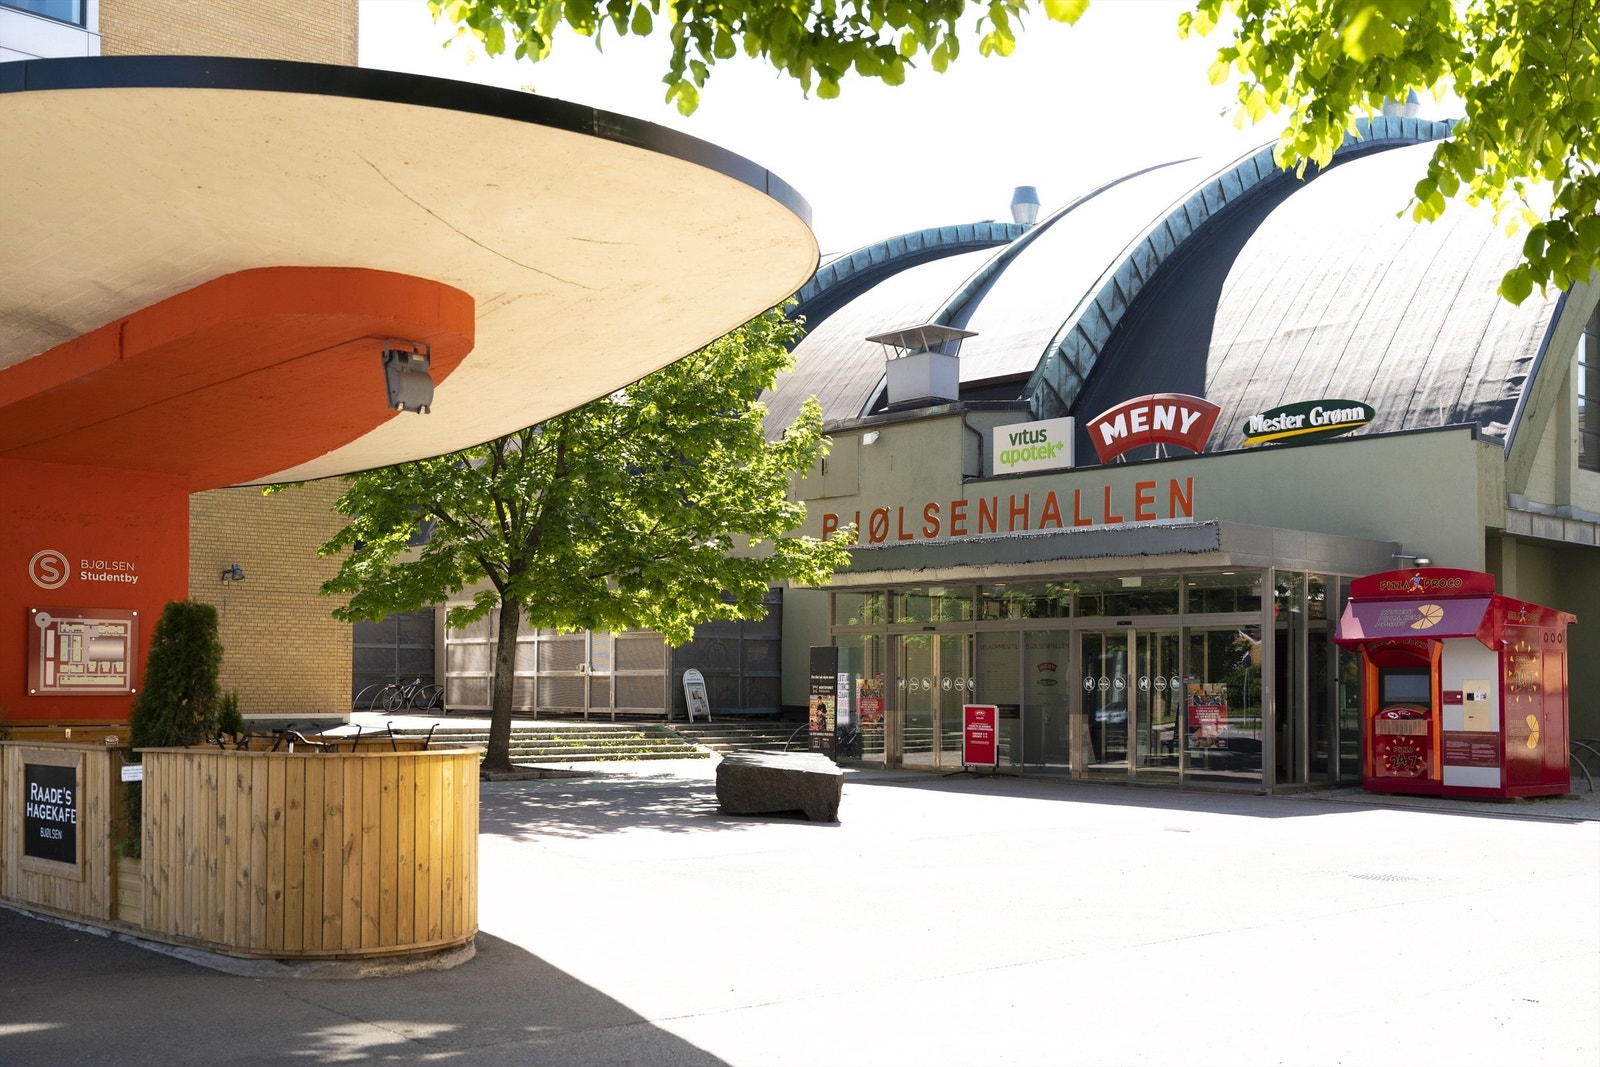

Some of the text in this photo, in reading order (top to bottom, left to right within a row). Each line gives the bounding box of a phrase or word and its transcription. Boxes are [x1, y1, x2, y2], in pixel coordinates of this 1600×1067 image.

[1099, 405, 1202, 446] MENY
[1249, 406, 1366, 434] Mester Grønn
[1009, 428, 1048, 446] vitus
[81, 559, 135, 571] BJØLSEN
[80, 571, 139, 584] Studentby
[1380, 577, 1463, 591] PIZZA PROCO
[31, 782, 72, 805] RAADE'S
[26, 802, 76, 824] HAGEKAFE
[40, 827, 63, 840] BJØLSEN
